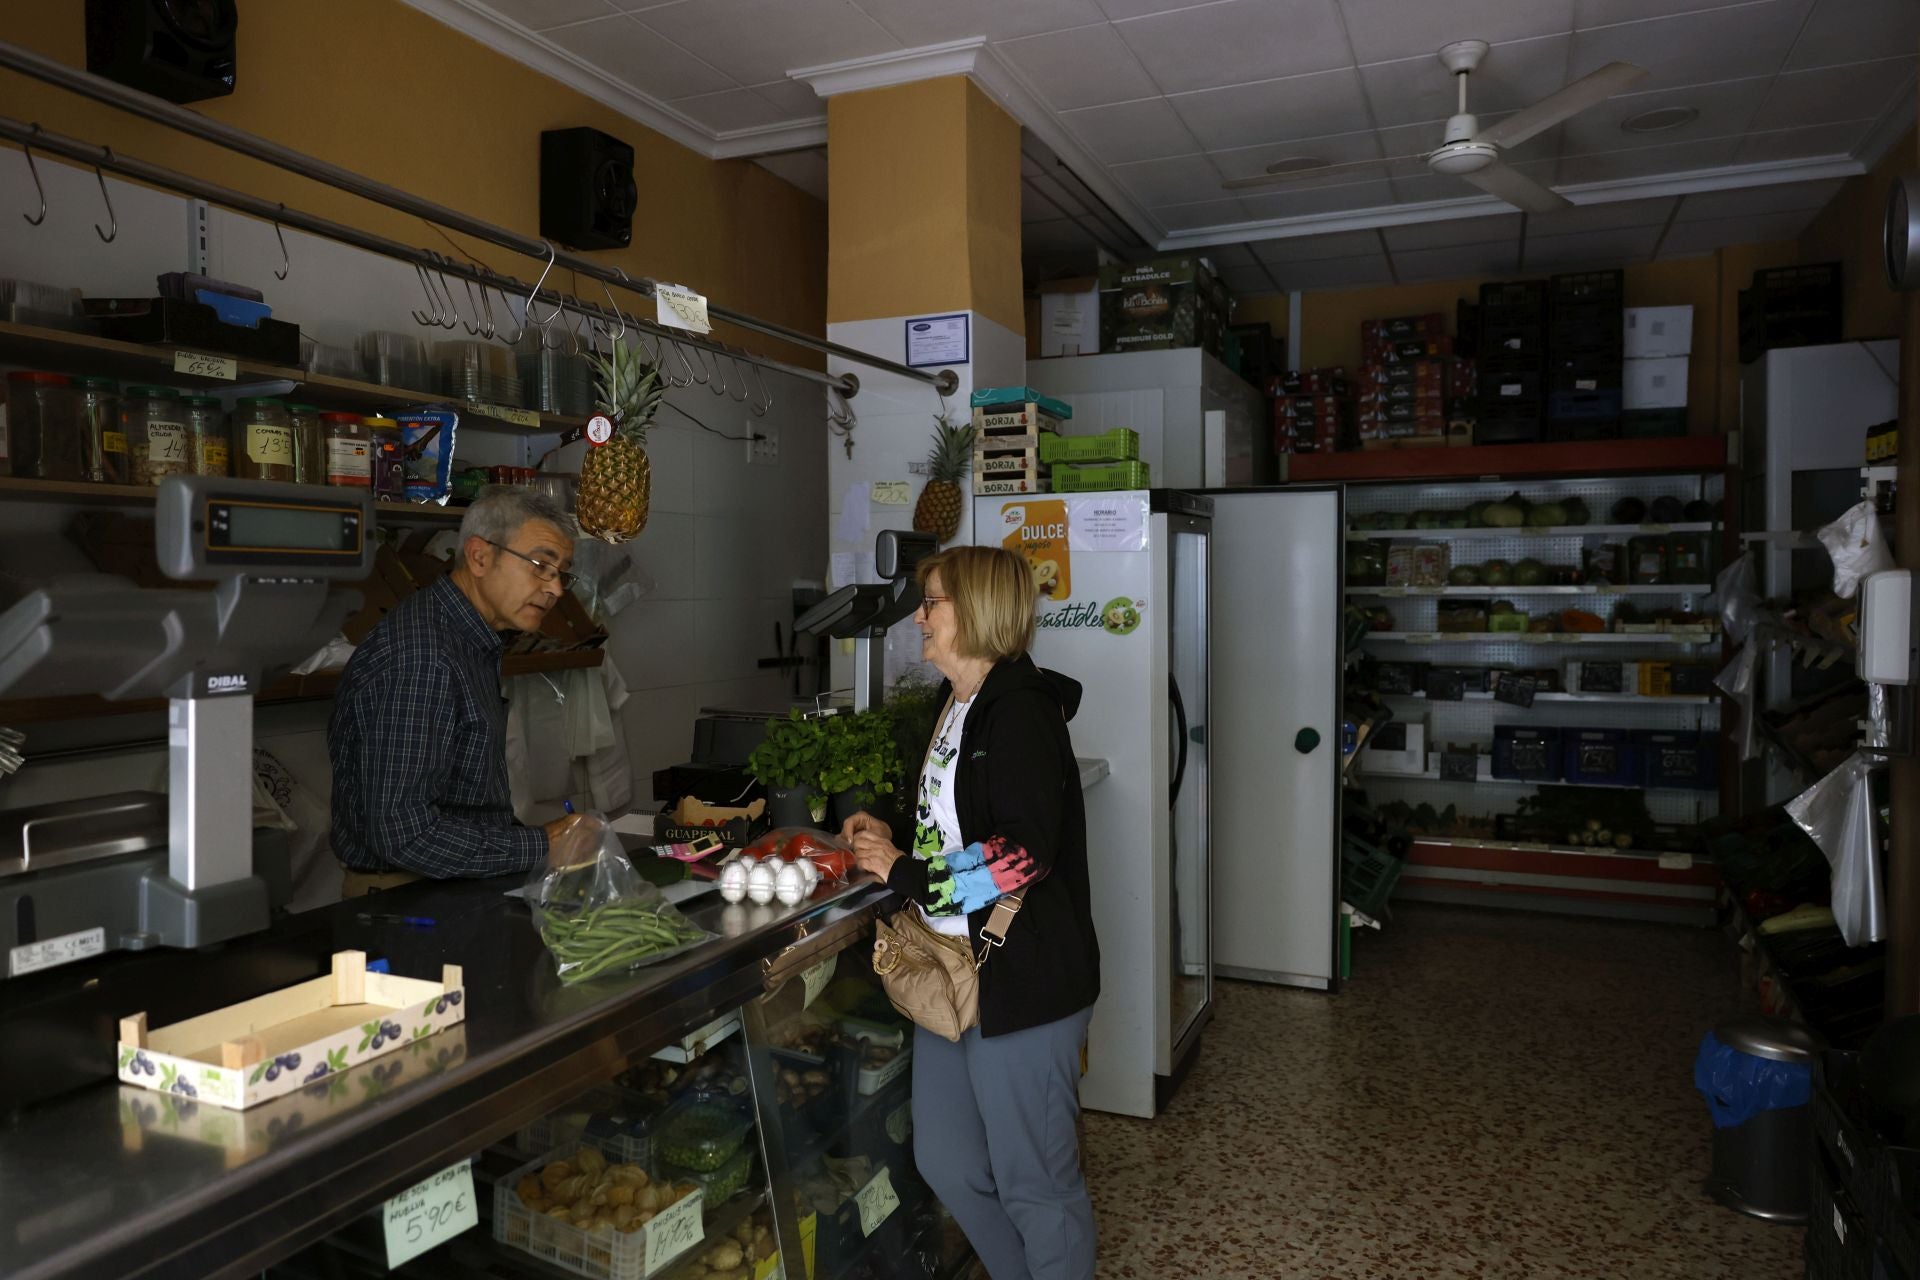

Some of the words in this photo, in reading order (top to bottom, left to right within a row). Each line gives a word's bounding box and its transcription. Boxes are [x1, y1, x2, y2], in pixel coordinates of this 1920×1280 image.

[1121, 271, 1171, 283] EXTRADULCE
[1116, 334, 1152, 344] PREMIUM
[1152, 333, 1174, 341] GOLD
[985, 416, 1015, 427] BORJA
[985, 460, 1016, 471] BORJA
[984, 483, 1014, 494] BORJA
[1022, 523, 1064, 541] DULCE
[207, 675, 248, 689] DIBAL
[405, 1191, 467, 1243] 5'90€
